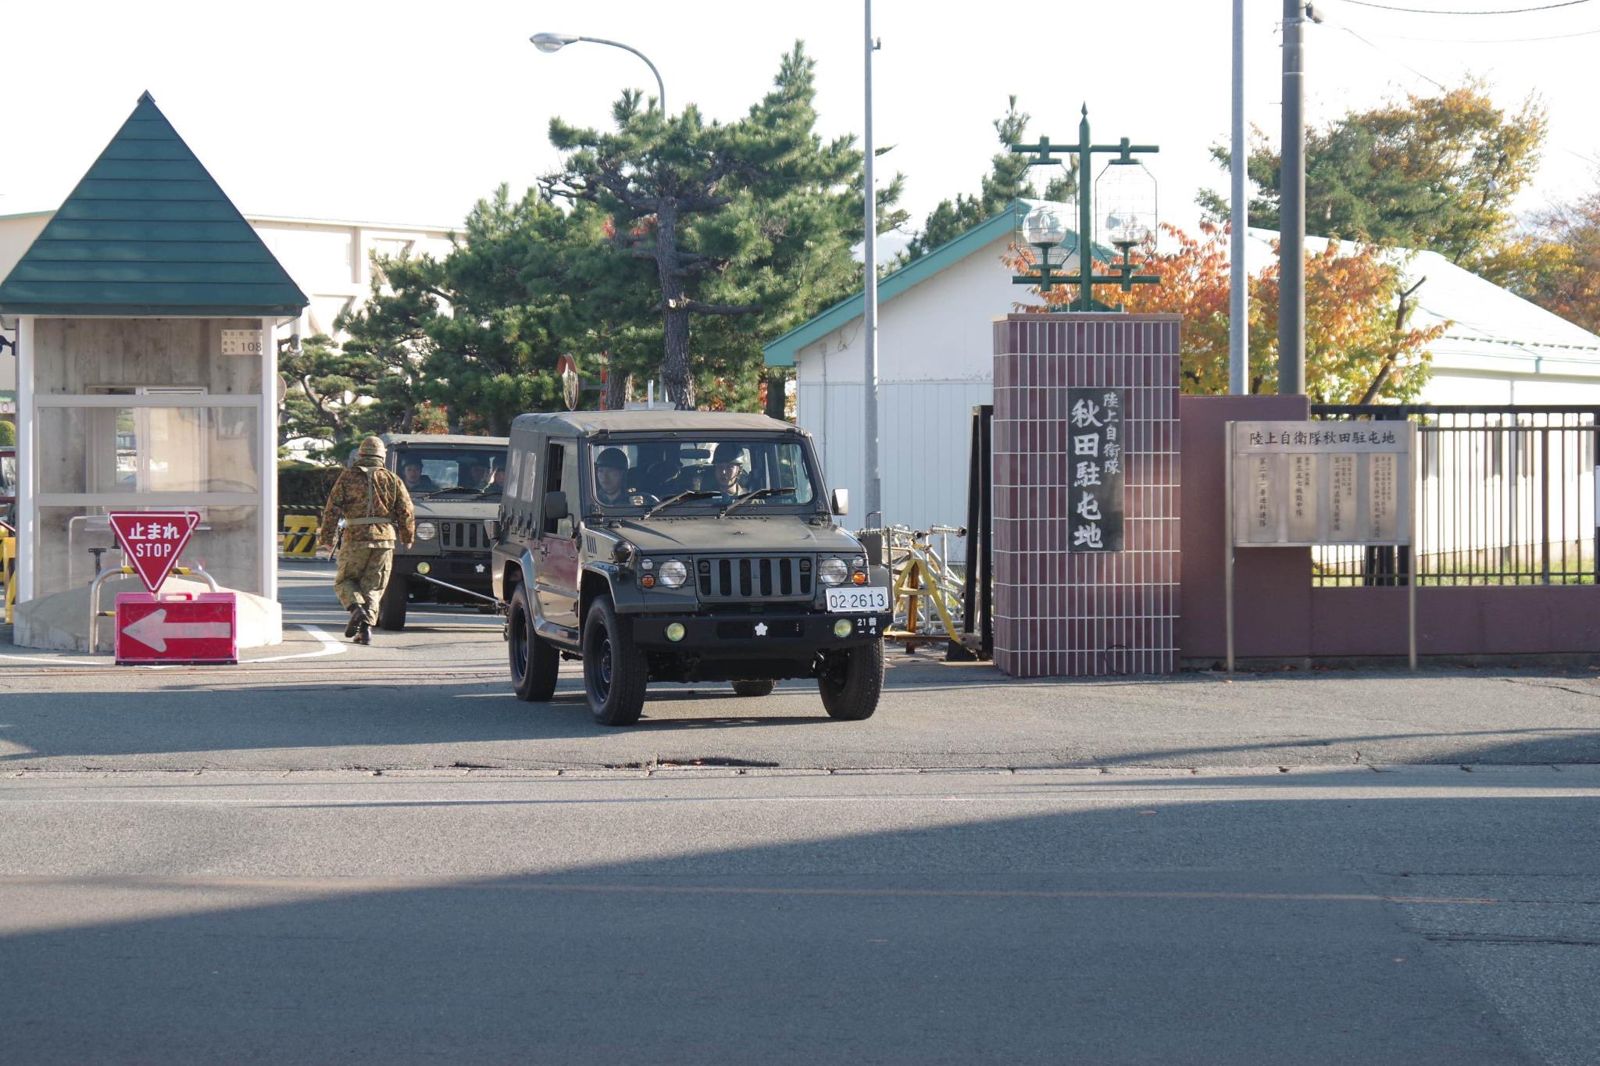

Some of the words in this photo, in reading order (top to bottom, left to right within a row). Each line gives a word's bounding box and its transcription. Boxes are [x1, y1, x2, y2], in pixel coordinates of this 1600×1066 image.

[241, 342, 262, 352] 108
[1103, 392, 1121, 474] 陸上自衛隊
[1249, 431, 1396, 446] 陸上自衛隊秋田駐屯地
[1071, 398, 1103, 548] 秋田駐屯地
[128, 522, 180, 540] 止まれ
[136, 543, 171, 557] STOP
